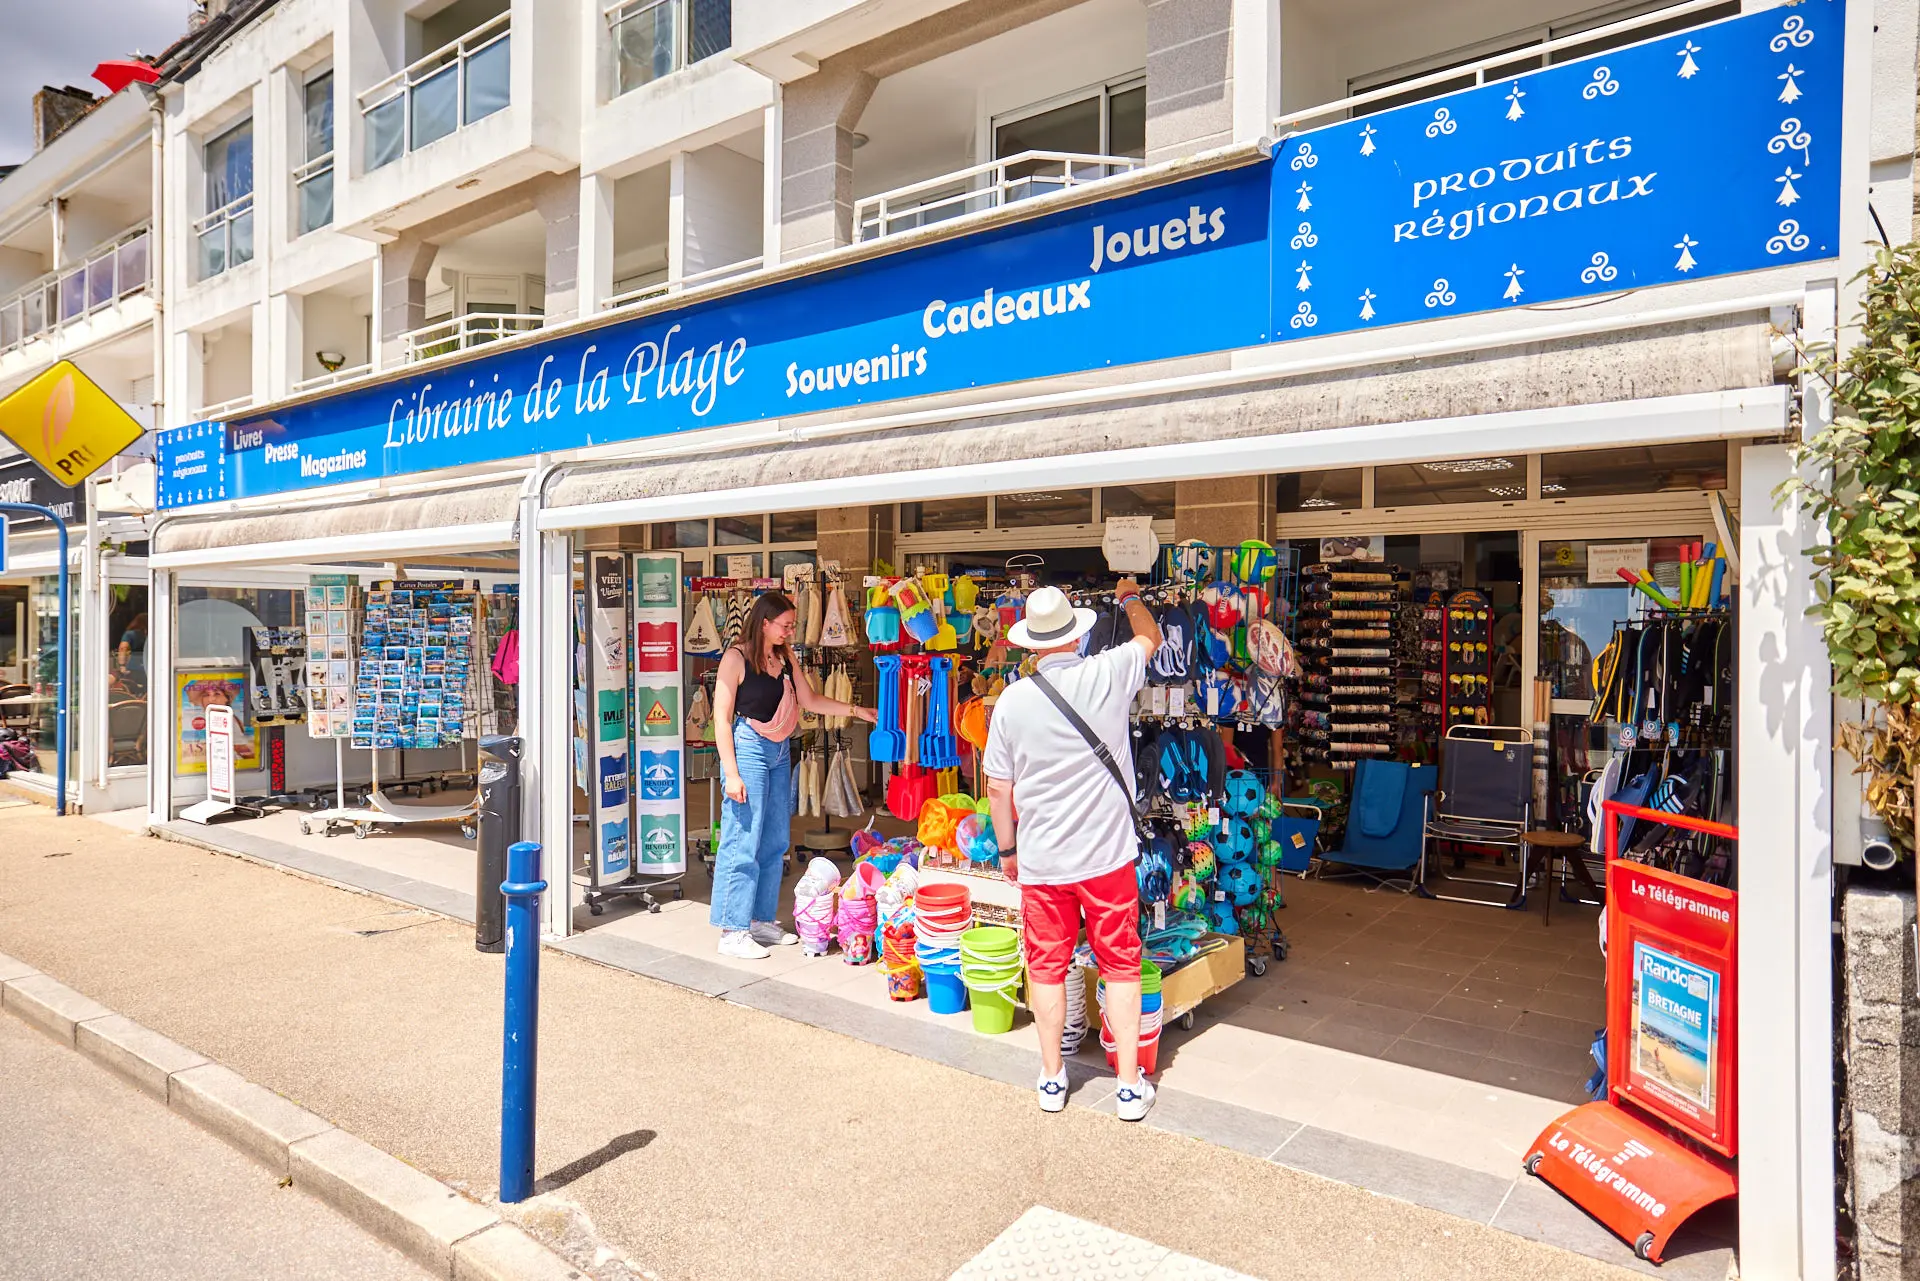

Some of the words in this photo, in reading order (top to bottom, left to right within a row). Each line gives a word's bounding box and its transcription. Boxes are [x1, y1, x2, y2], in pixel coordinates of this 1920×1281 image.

[1413, 135, 1632, 208] produits
[1394, 172, 1657, 243] régionaux
[1089, 206, 1226, 273] Jouets
[922, 279, 1091, 338] Cadeaux
[383, 373, 513, 449] Librairie
[523, 355, 562, 424] de
[574, 345, 611, 414] la
[622, 324, 747, 417] Plage
[785, 343, 928, 398] Souvenirs
[233, 429, 263, 450] Livres
[265, 442, 299, 464] Presse
[301, 448, 367, 478] Magazines
[1631, 880, 1645, 897] Le
[1648, 885, 1730, 924] Télégramme
[1648, 991, 1702, 1026] BRETAGNE
[1549, 1131, 1569, 1152] Le
[1569, 1143, 1667, 1218] Télégramme
